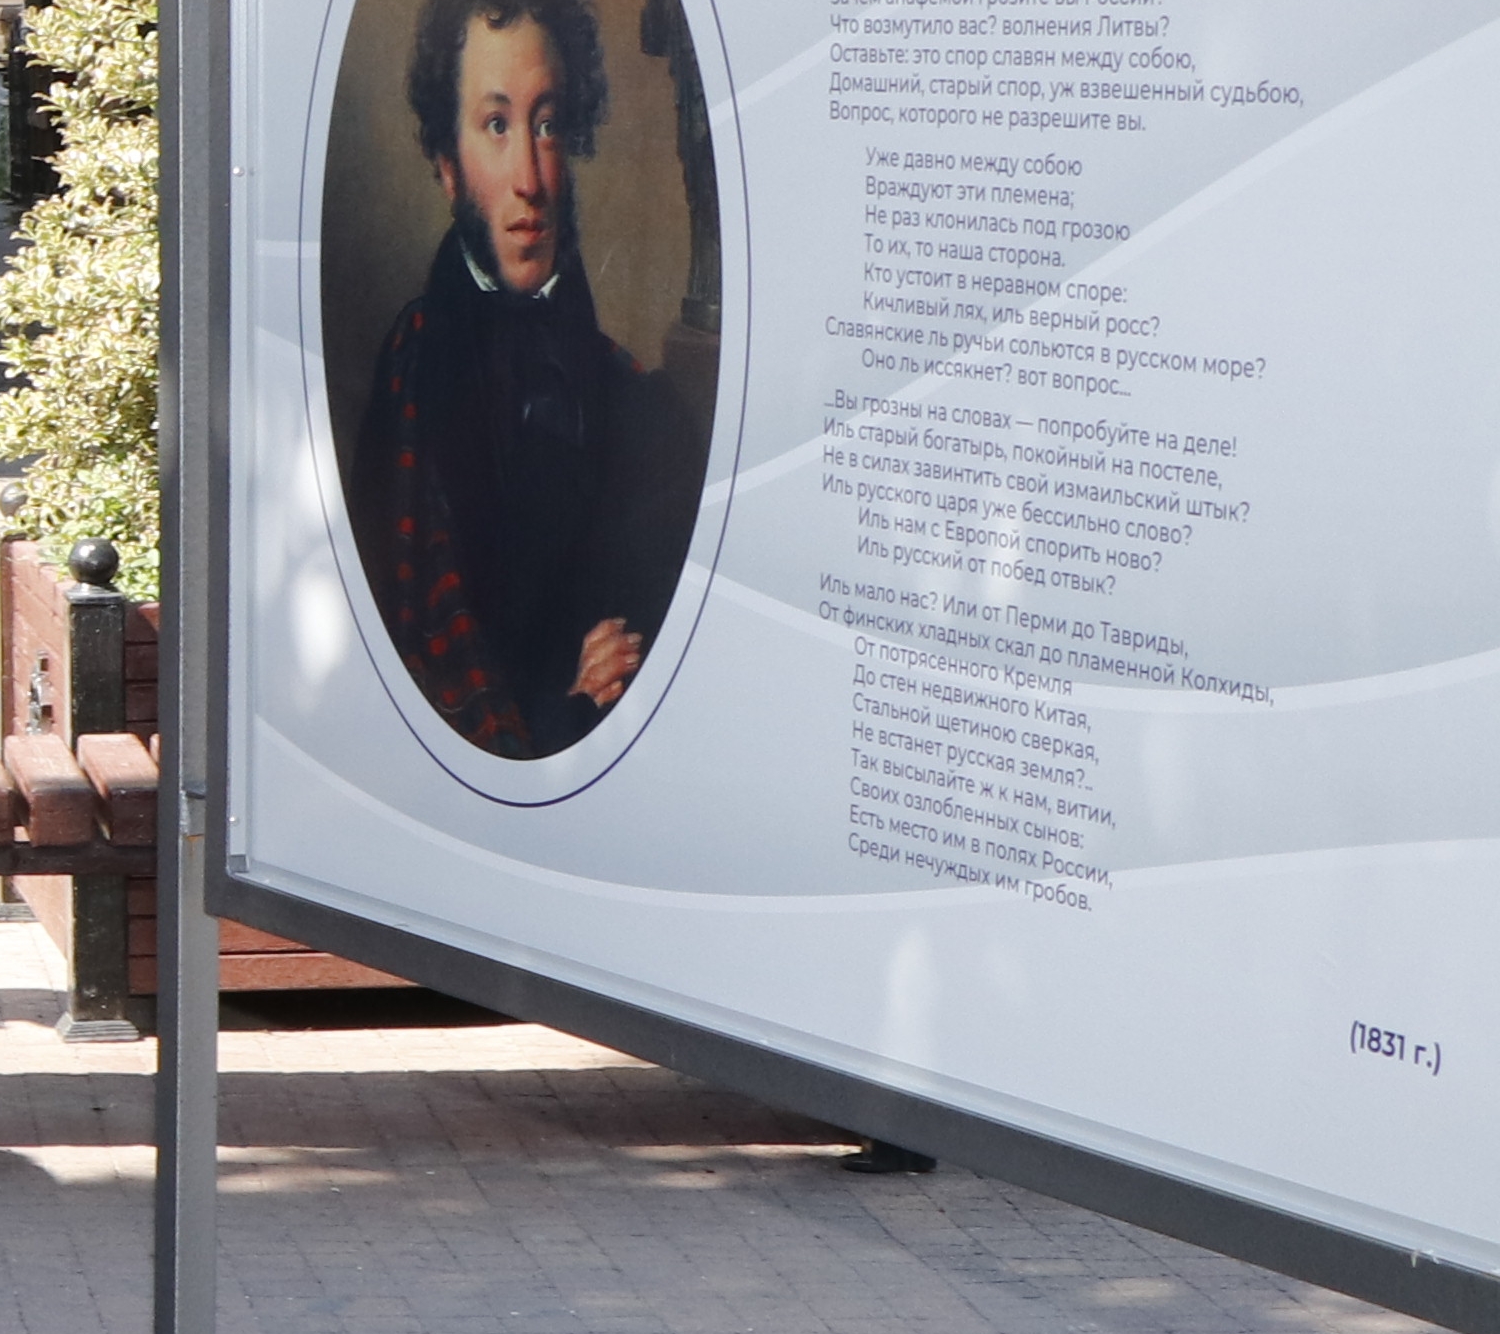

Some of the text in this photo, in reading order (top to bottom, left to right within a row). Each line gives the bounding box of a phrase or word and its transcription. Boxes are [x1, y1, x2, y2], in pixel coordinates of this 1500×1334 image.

[862, 13, 1170, 40] возмутило волнения Литвы?
[829, 41, 1196, 74] Оставьте: спор славян между собою,
[827, 70, 1304, 108] Домашний, старый спор, взвешенный судьбою,
[828, 98, 1112, 133] Вопрос, которого разрешите
[864, 173, 1075, 211] Враждуют племена;
[901, 151, 1083, 179] давно между собою
[924, 211, 1131, 243] клонилась грозою
[937, 241, 1066, 270] наша сторона.
[862, 289, 1161, 338] Кичливый верный росс?
[895, 267, 1128, 307] устоит неравном споре:
[824, 314, 1267, 382] Славянские ручьи сольются русском море?
[922, 358, 1013, 384] иссякнет?
[861, 395, 1237, 458] грозны словах попробуйте деле!
[856, 423, 1223, 491] старый богатырь, покойный постеле,
[855, 480, 1193, 546] русского царя бессильно слово?
[860, 452, 1251, 523] силах завинтить свой измаильский штык?
[891, 543, 1116, 596] русский побед отвык?
[944, 518, 1163, 573] Европой спорить ново?
[853, 581, 1189, 660] мало Перми Тавриды,
[841, 603, 1275, 708] финских хладных скал пламенной Колхиды,
[878, 643, 1073, 696] потрясенного Кремля
[851, 690, 1099, 766] Стальной щетиною сверкая,
[878, 671, 1091, 734] стен недвижного Китая,
[877, 728, 944, 757] встанет
[945, 743, 1016, 774] русская
[848, 774, 1085, 850] Своих озлобленных сынов:
[881, 757, 1116, 830] высылайте витии,
[847, 830, 1092, 912] Среди нечуждых гробов.
[848, 802, 1113, 890] Есть место полях России,
[1350, 1020, 1441, 1077] (1831 г.)
